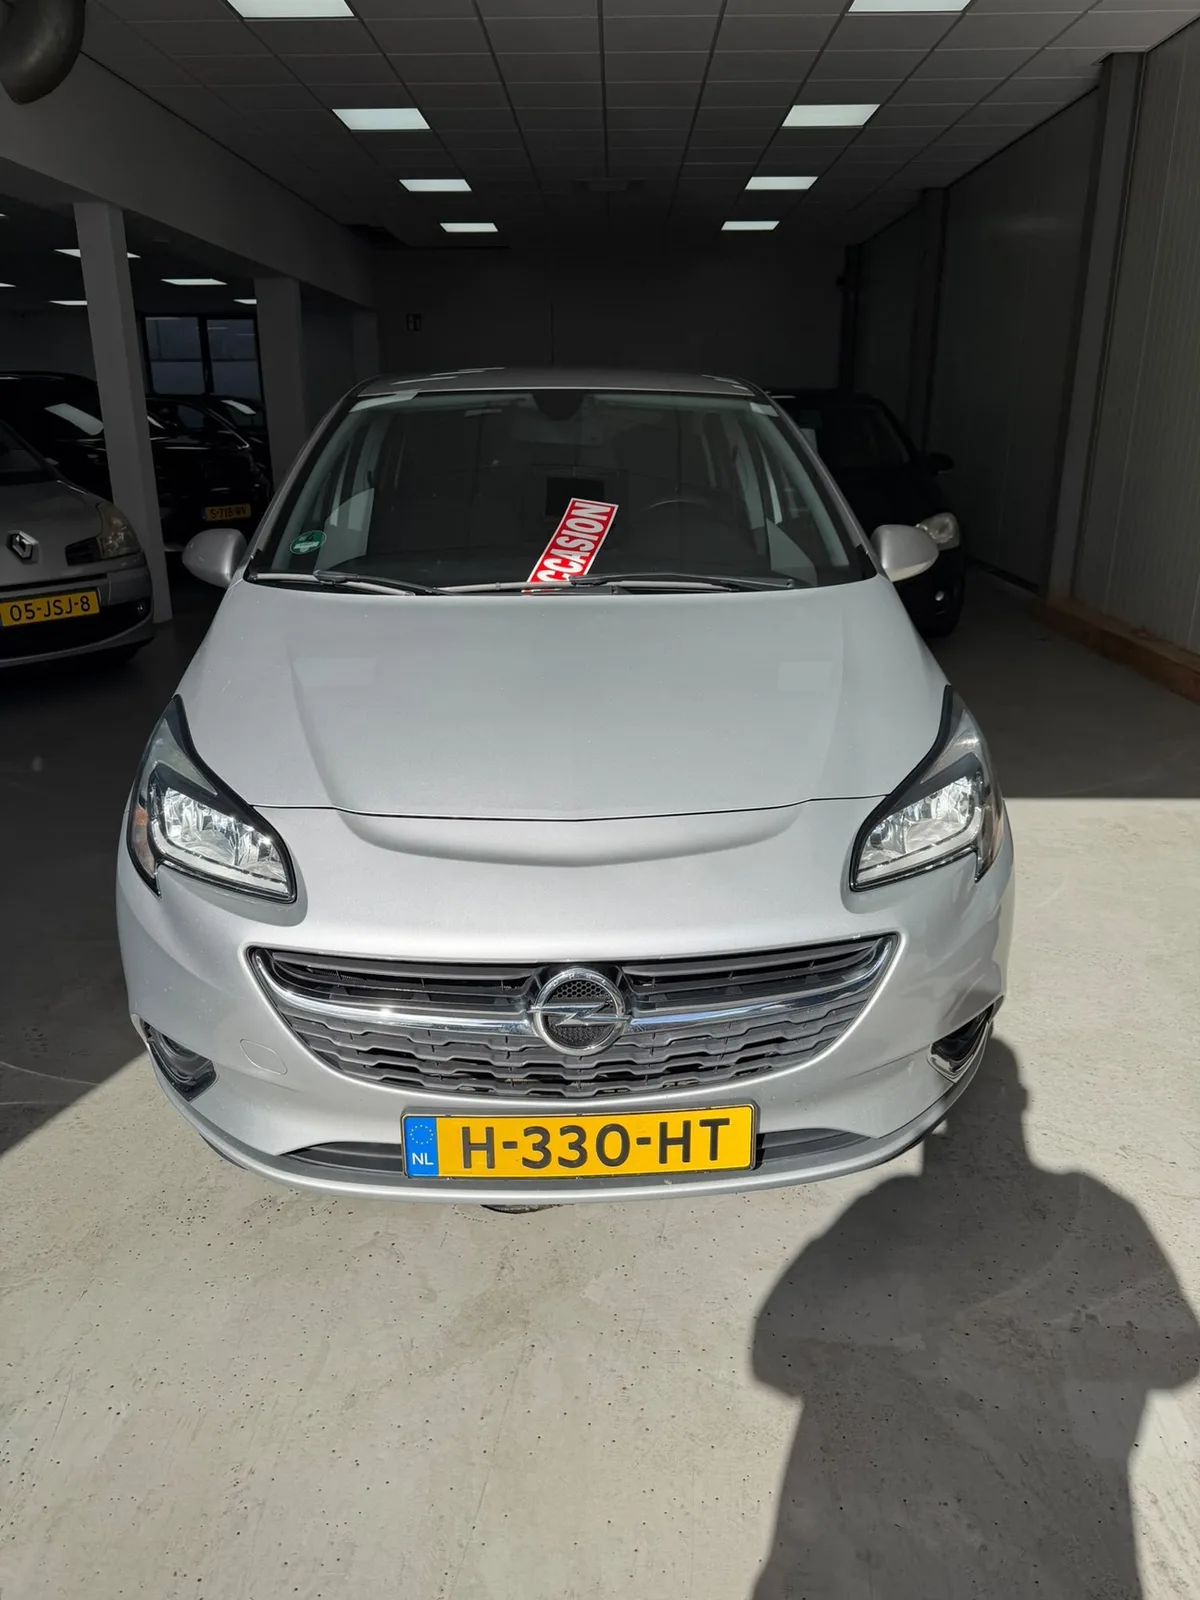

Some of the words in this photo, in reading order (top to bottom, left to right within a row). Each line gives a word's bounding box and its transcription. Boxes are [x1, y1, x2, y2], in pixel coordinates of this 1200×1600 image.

[530, 501, 612, 584] CCASION
[9, 595, 91, 622] 05-JSJ-8
[412, 1152, 434, 1166] NL
[461, 1117, 730, 1170] H-330-HT
